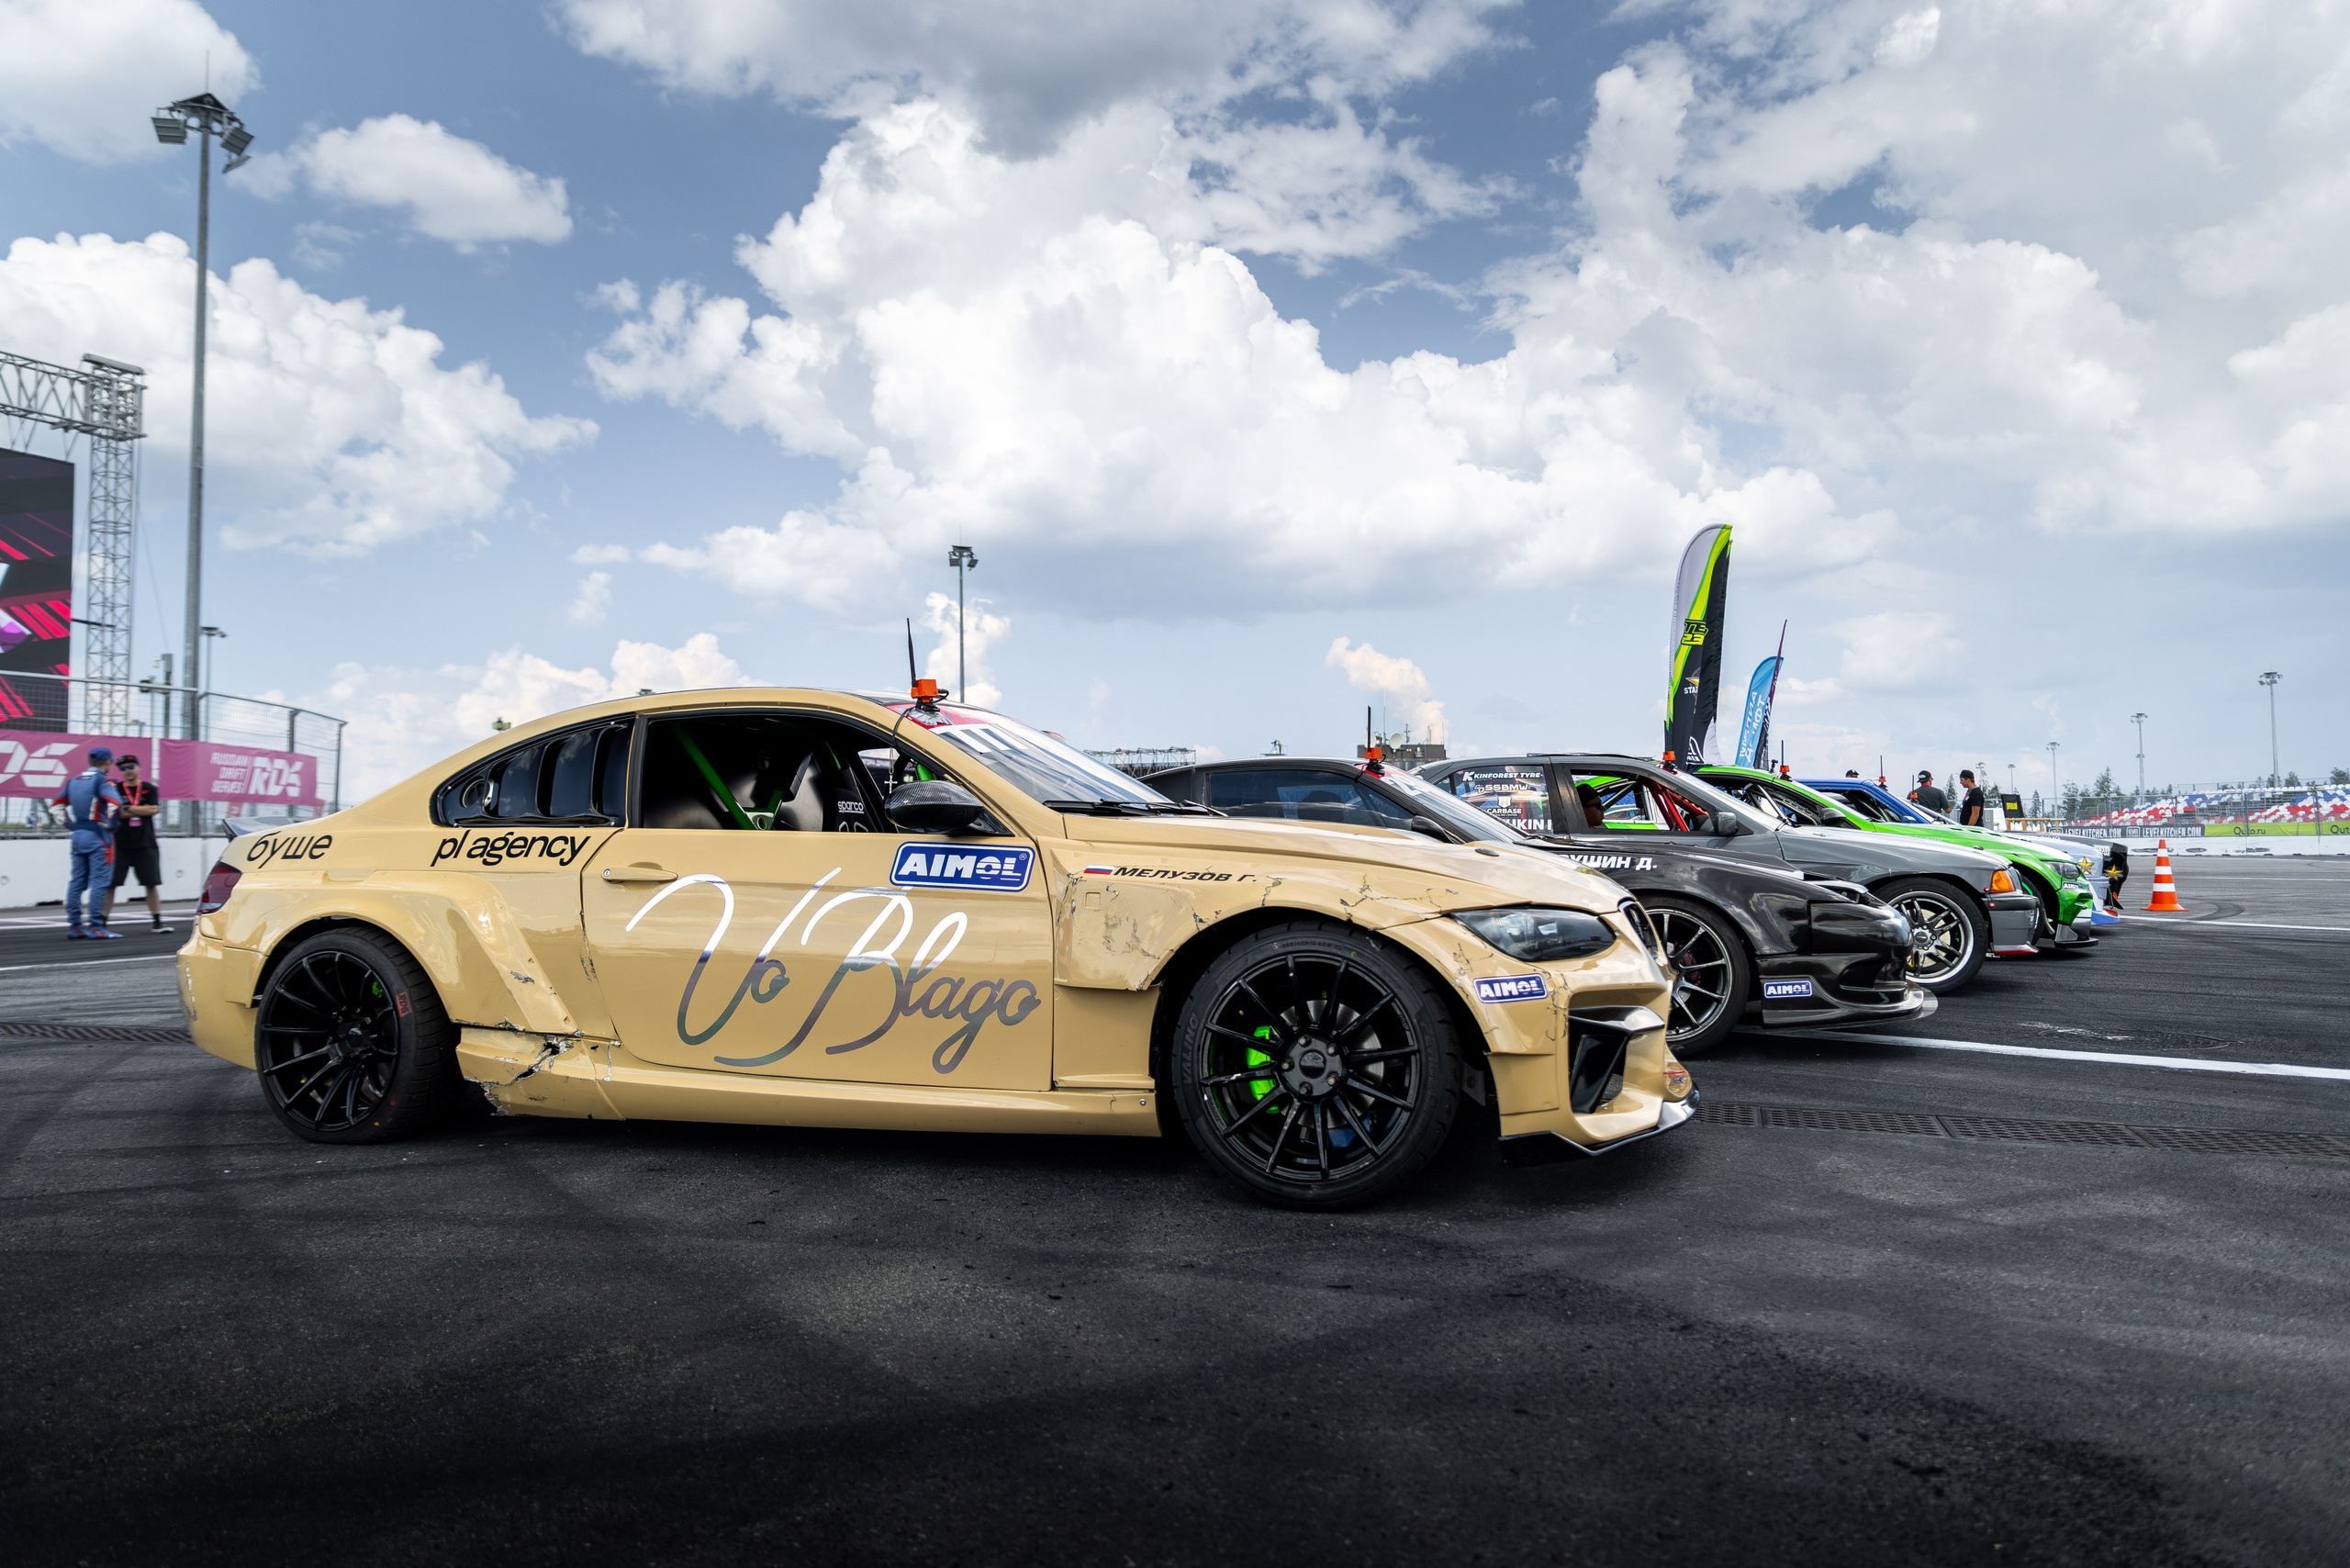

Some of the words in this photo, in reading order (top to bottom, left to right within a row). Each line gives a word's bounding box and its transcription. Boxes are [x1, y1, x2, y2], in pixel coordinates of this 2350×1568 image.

[1681, 633, 1706, 645] 23
[837, 801, 864, 813] sparco
[246, 830, 333, 869] буше
[466, 831, 592, 866] agency
[1113, 867, 1233, 882] МЕЛУЗОВ
[714, 885, 1042, 1074] Blago
[1480, 980, 1543, 998] AIMOL
[1766, 984, 1810, 995] AIMOL
